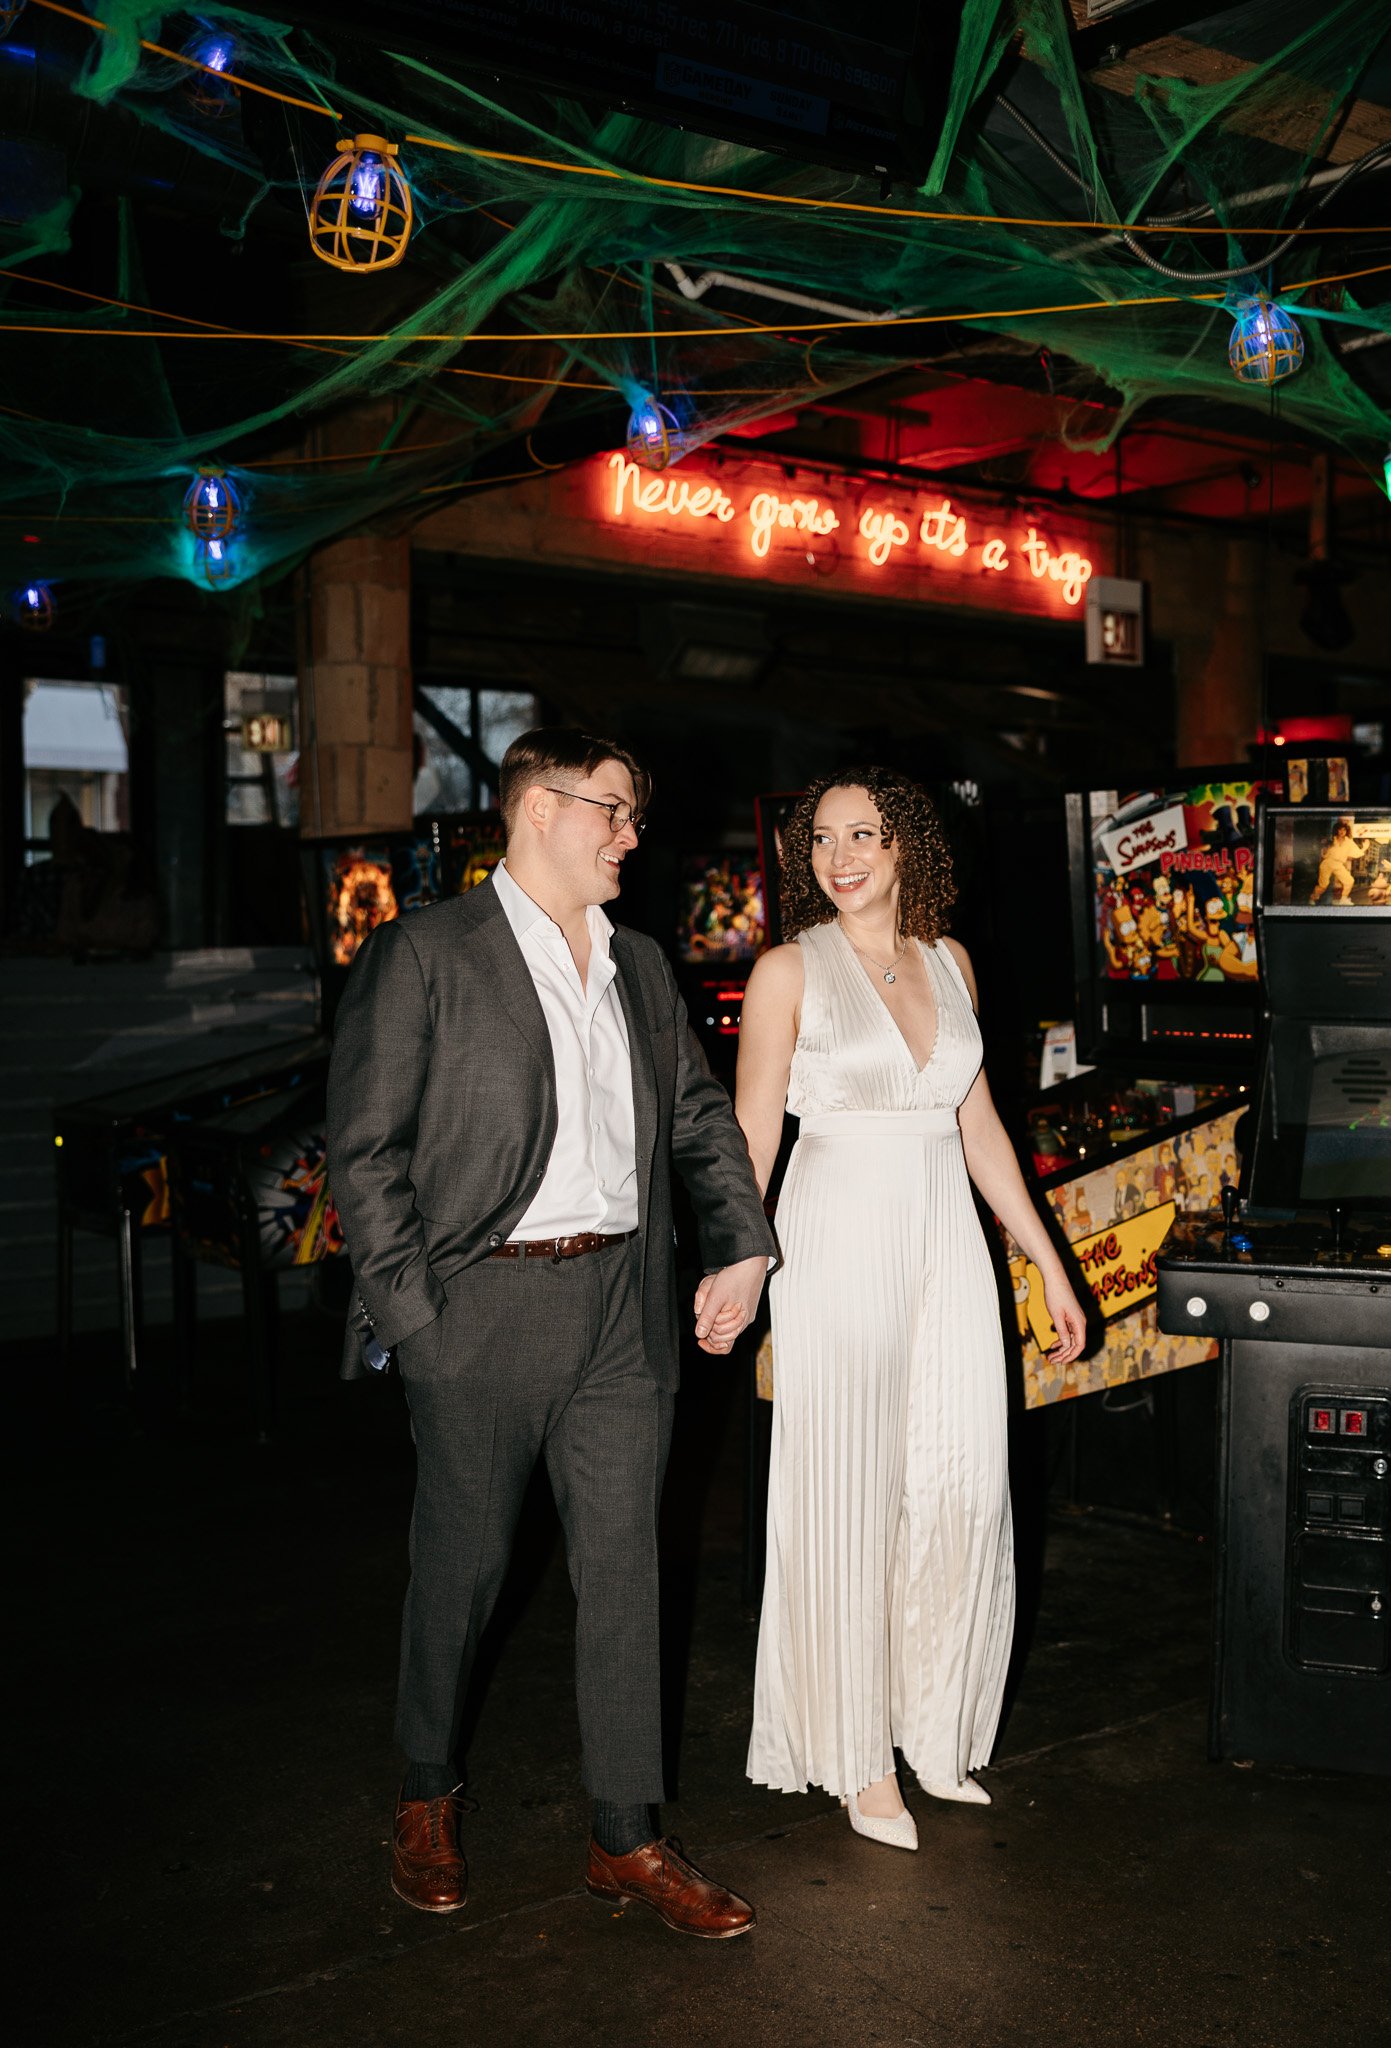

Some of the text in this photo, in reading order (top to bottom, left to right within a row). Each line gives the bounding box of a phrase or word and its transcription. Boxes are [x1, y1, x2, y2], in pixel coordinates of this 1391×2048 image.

[683, 66, 752, 99] GAMEDAY
[790, 40, 811, 71] TD
[813, 50, 841, 80] this
[844, 65, 897, 97] season
[769, 90, 813, 111] SUNDAY
[609, 453, 1092, 605] Never grow up its a trap
[1160, 848, 1231, 875] PINBALL
